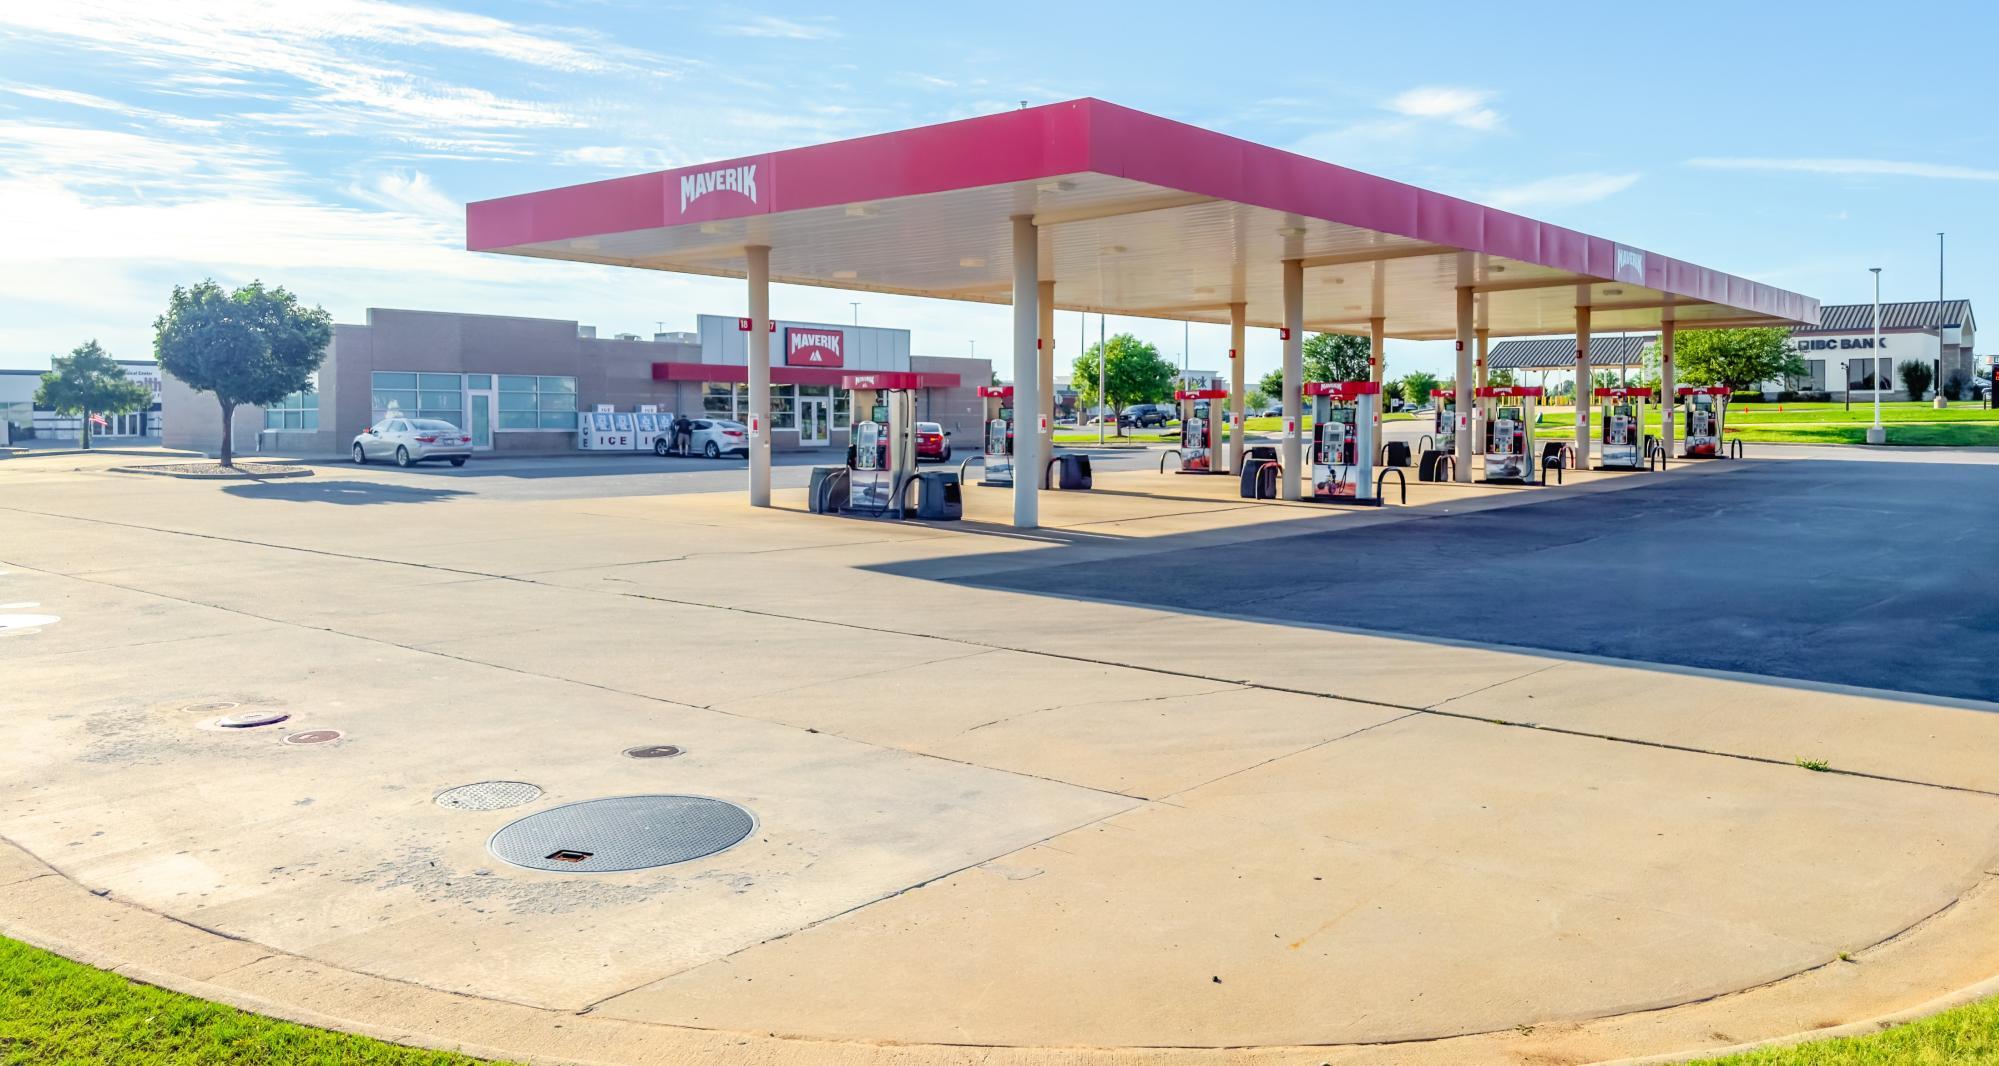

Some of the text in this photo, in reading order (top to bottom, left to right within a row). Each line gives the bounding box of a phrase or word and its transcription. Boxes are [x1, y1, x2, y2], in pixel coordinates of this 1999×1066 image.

[681, 164, 757, 215] MAVERIK
[1617, 248, 1643, 279] MAVERIK
[740, 320, 748, 329] 18
[791, 333, 840, 358] MAVERIK
[1810, 337, 1887, 350] IBC BANK
[600, 436, 628, 445] ICE
